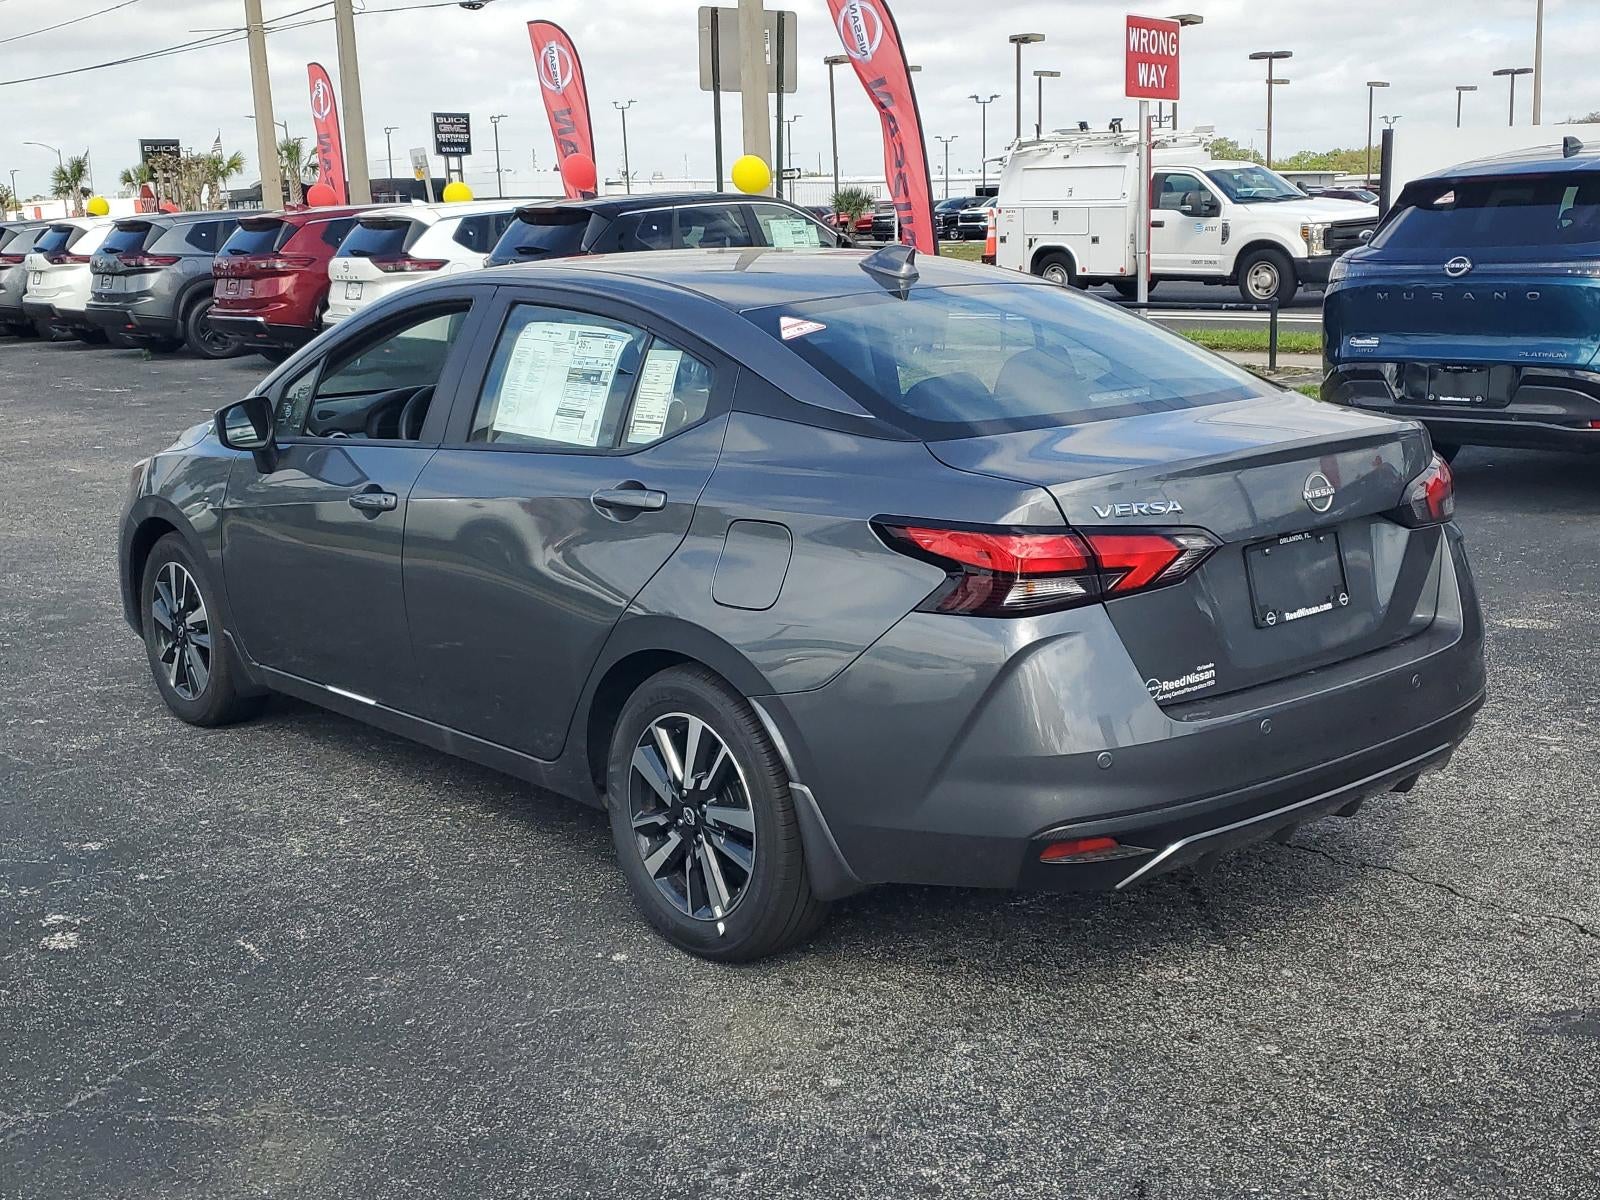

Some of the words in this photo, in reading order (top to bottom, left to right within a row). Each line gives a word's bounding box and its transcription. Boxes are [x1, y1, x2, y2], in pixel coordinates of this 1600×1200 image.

[1128, 26, 1177, 56] WRONG
[1138, 62, 1167, 88] WAY
[439, 124, 466, 132] GMC
[142, 198, 156, 212] STOP
[1376, 290, 1541, 301] MURANO
[1519, 351, 1567, 359] PLATINUM
[1304, 487, 1336, 500] NISSAN
[1092, 500, 1184, 519] VERSA
[1285, 603, 1332, 621] ReedNissan.com
[1163, 676, 1185, 691] Reed
[1186, 670, 1215, 684] Nissan
